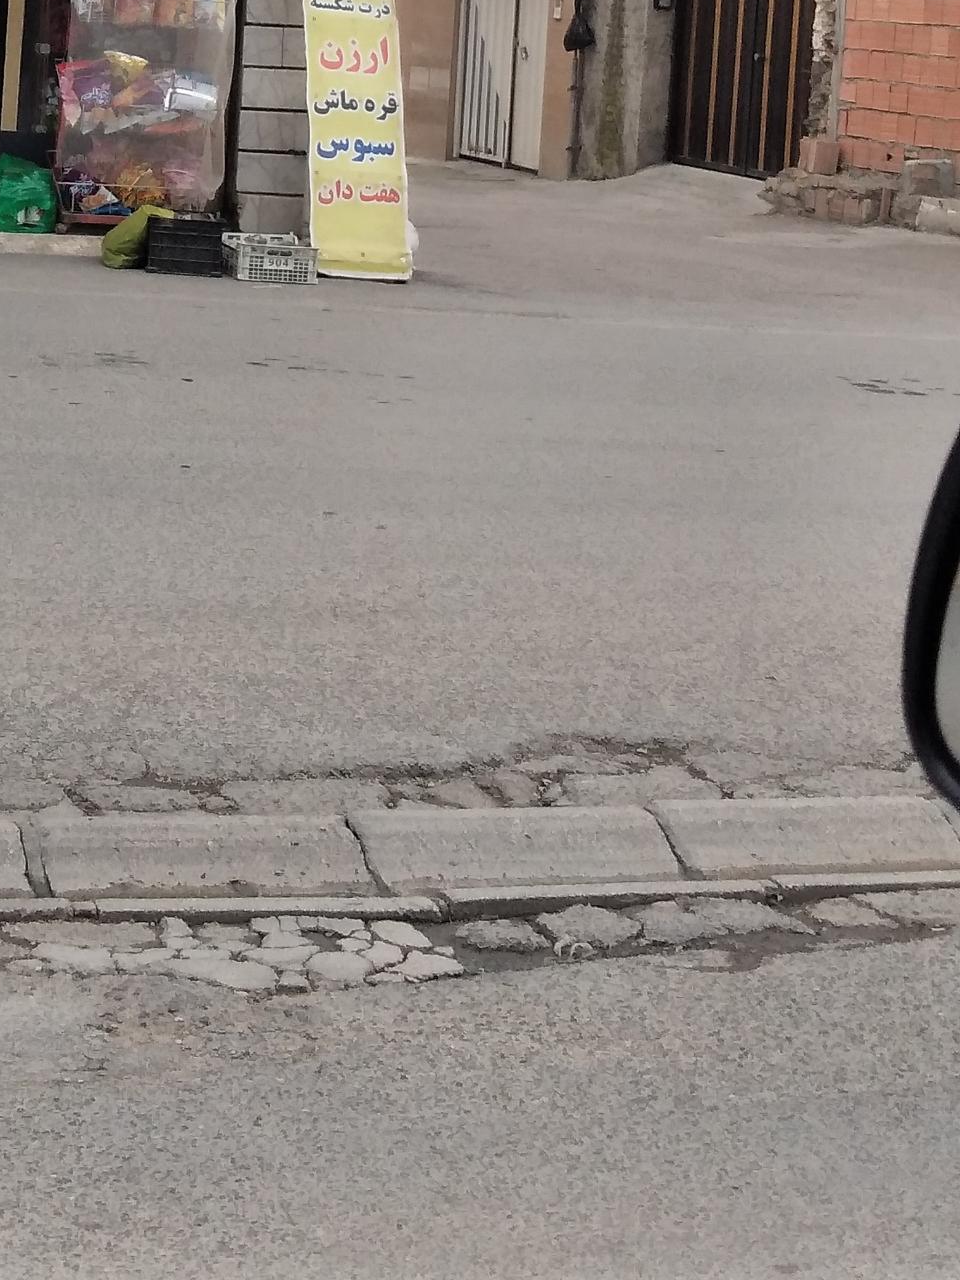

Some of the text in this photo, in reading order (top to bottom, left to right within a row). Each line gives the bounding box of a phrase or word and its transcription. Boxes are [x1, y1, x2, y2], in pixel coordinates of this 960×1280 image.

[320, 36, 389, 74] ارزن
[313, 89, 398, 120] قره ماش
[316, 136, 395, 162] سبوس
[317, 180, 401, 205] هفت دان
